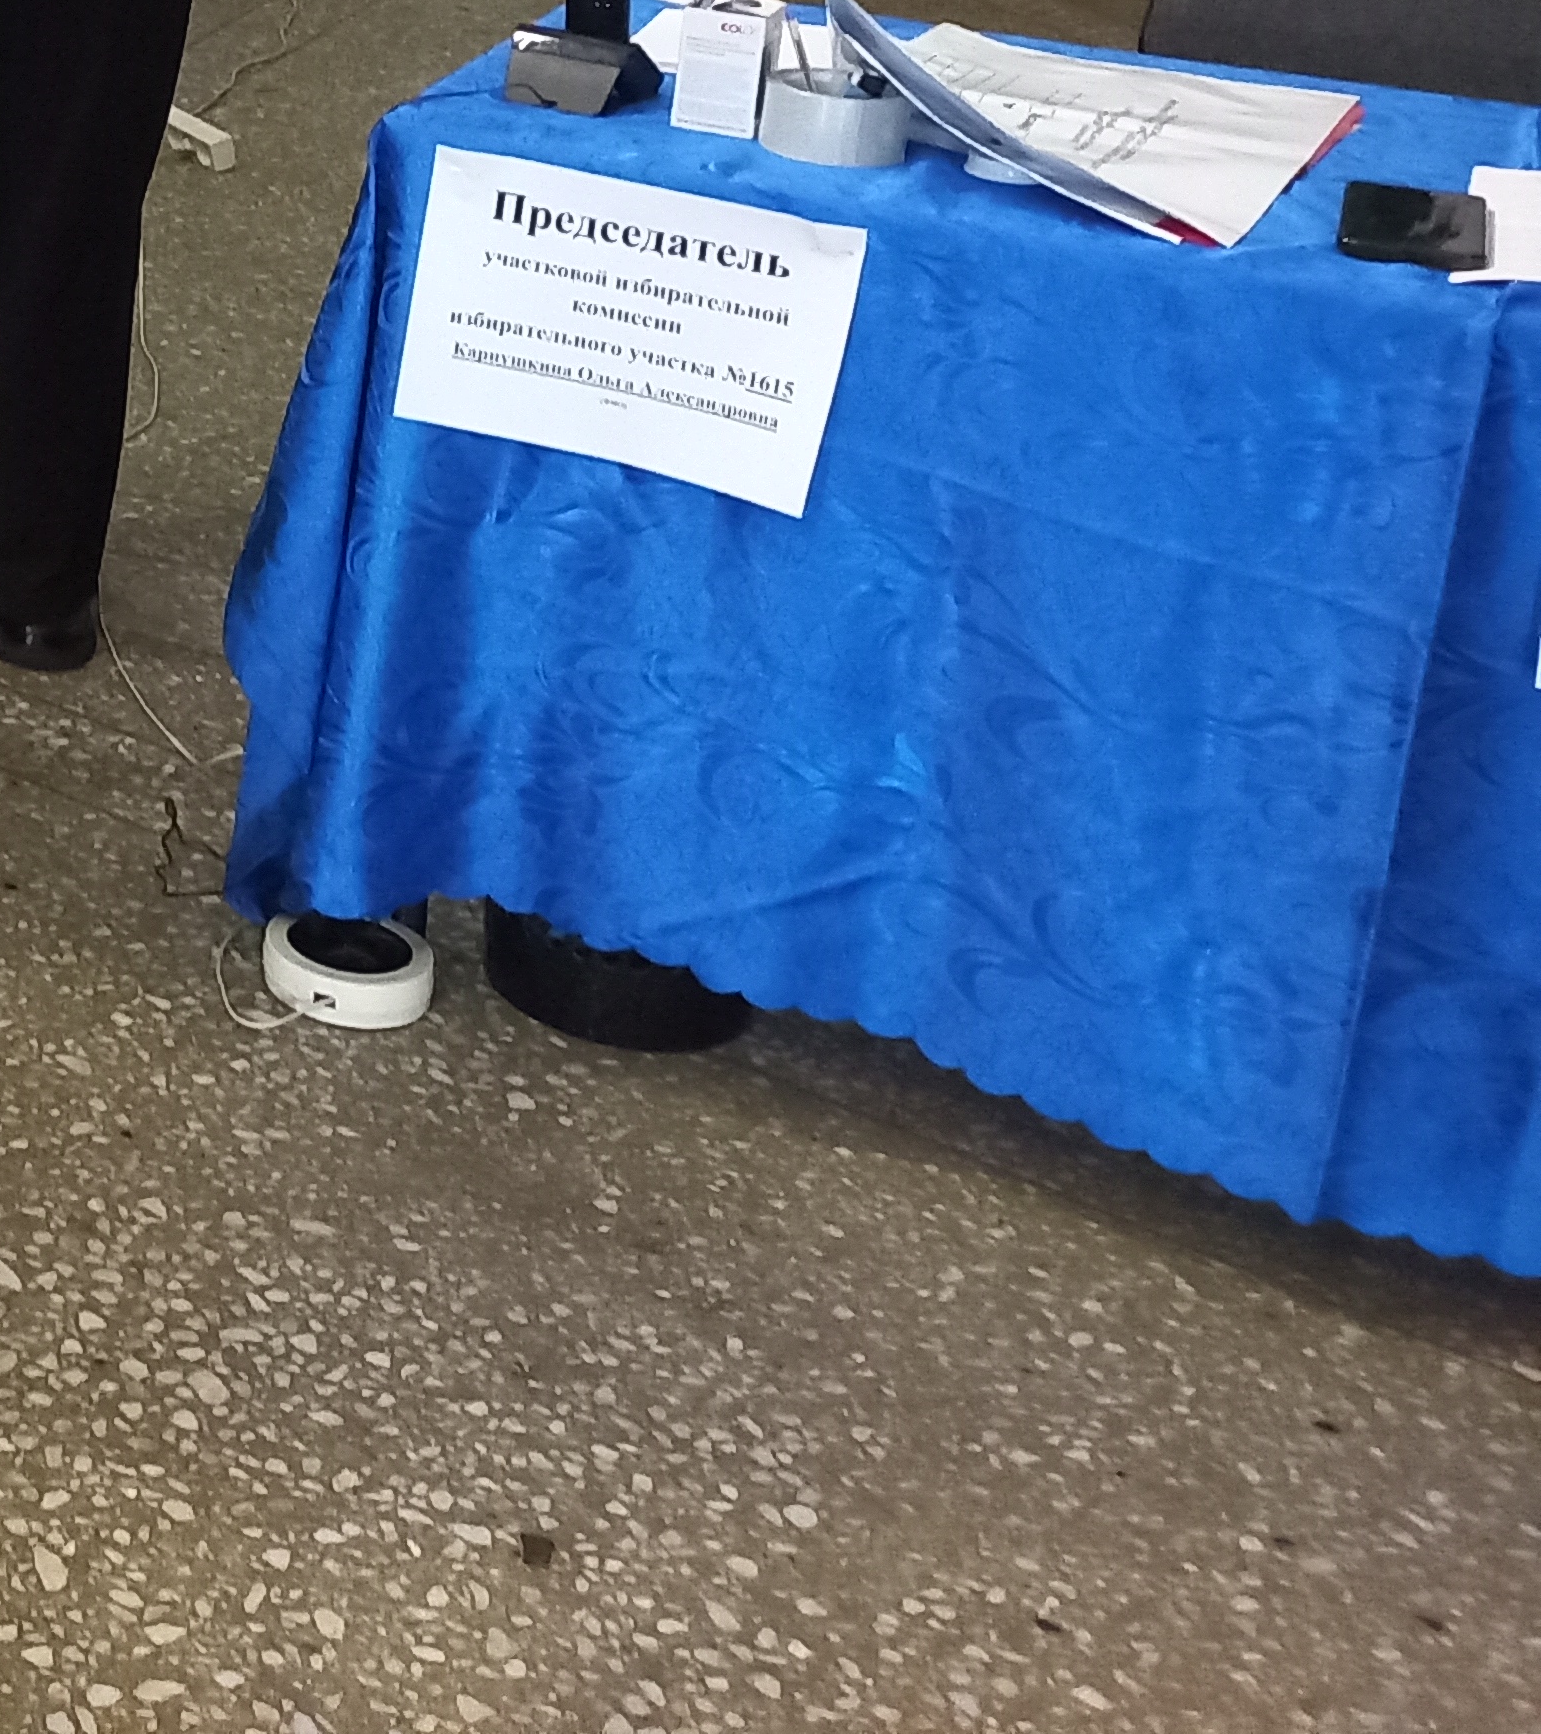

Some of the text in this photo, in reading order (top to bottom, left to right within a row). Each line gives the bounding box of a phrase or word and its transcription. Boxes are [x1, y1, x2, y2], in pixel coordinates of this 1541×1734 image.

[493, 190, 791, 278] Председатель
[483, 249, 791, 326] участковой избирательной
[571, 299, 682, 335] комиссии
[449, 311, 622, 356] избирательного
[627, 346, 715, 380] участка
[577, 366, 634, 393] Ольга
[640, 380, 779, 430] Александровна
